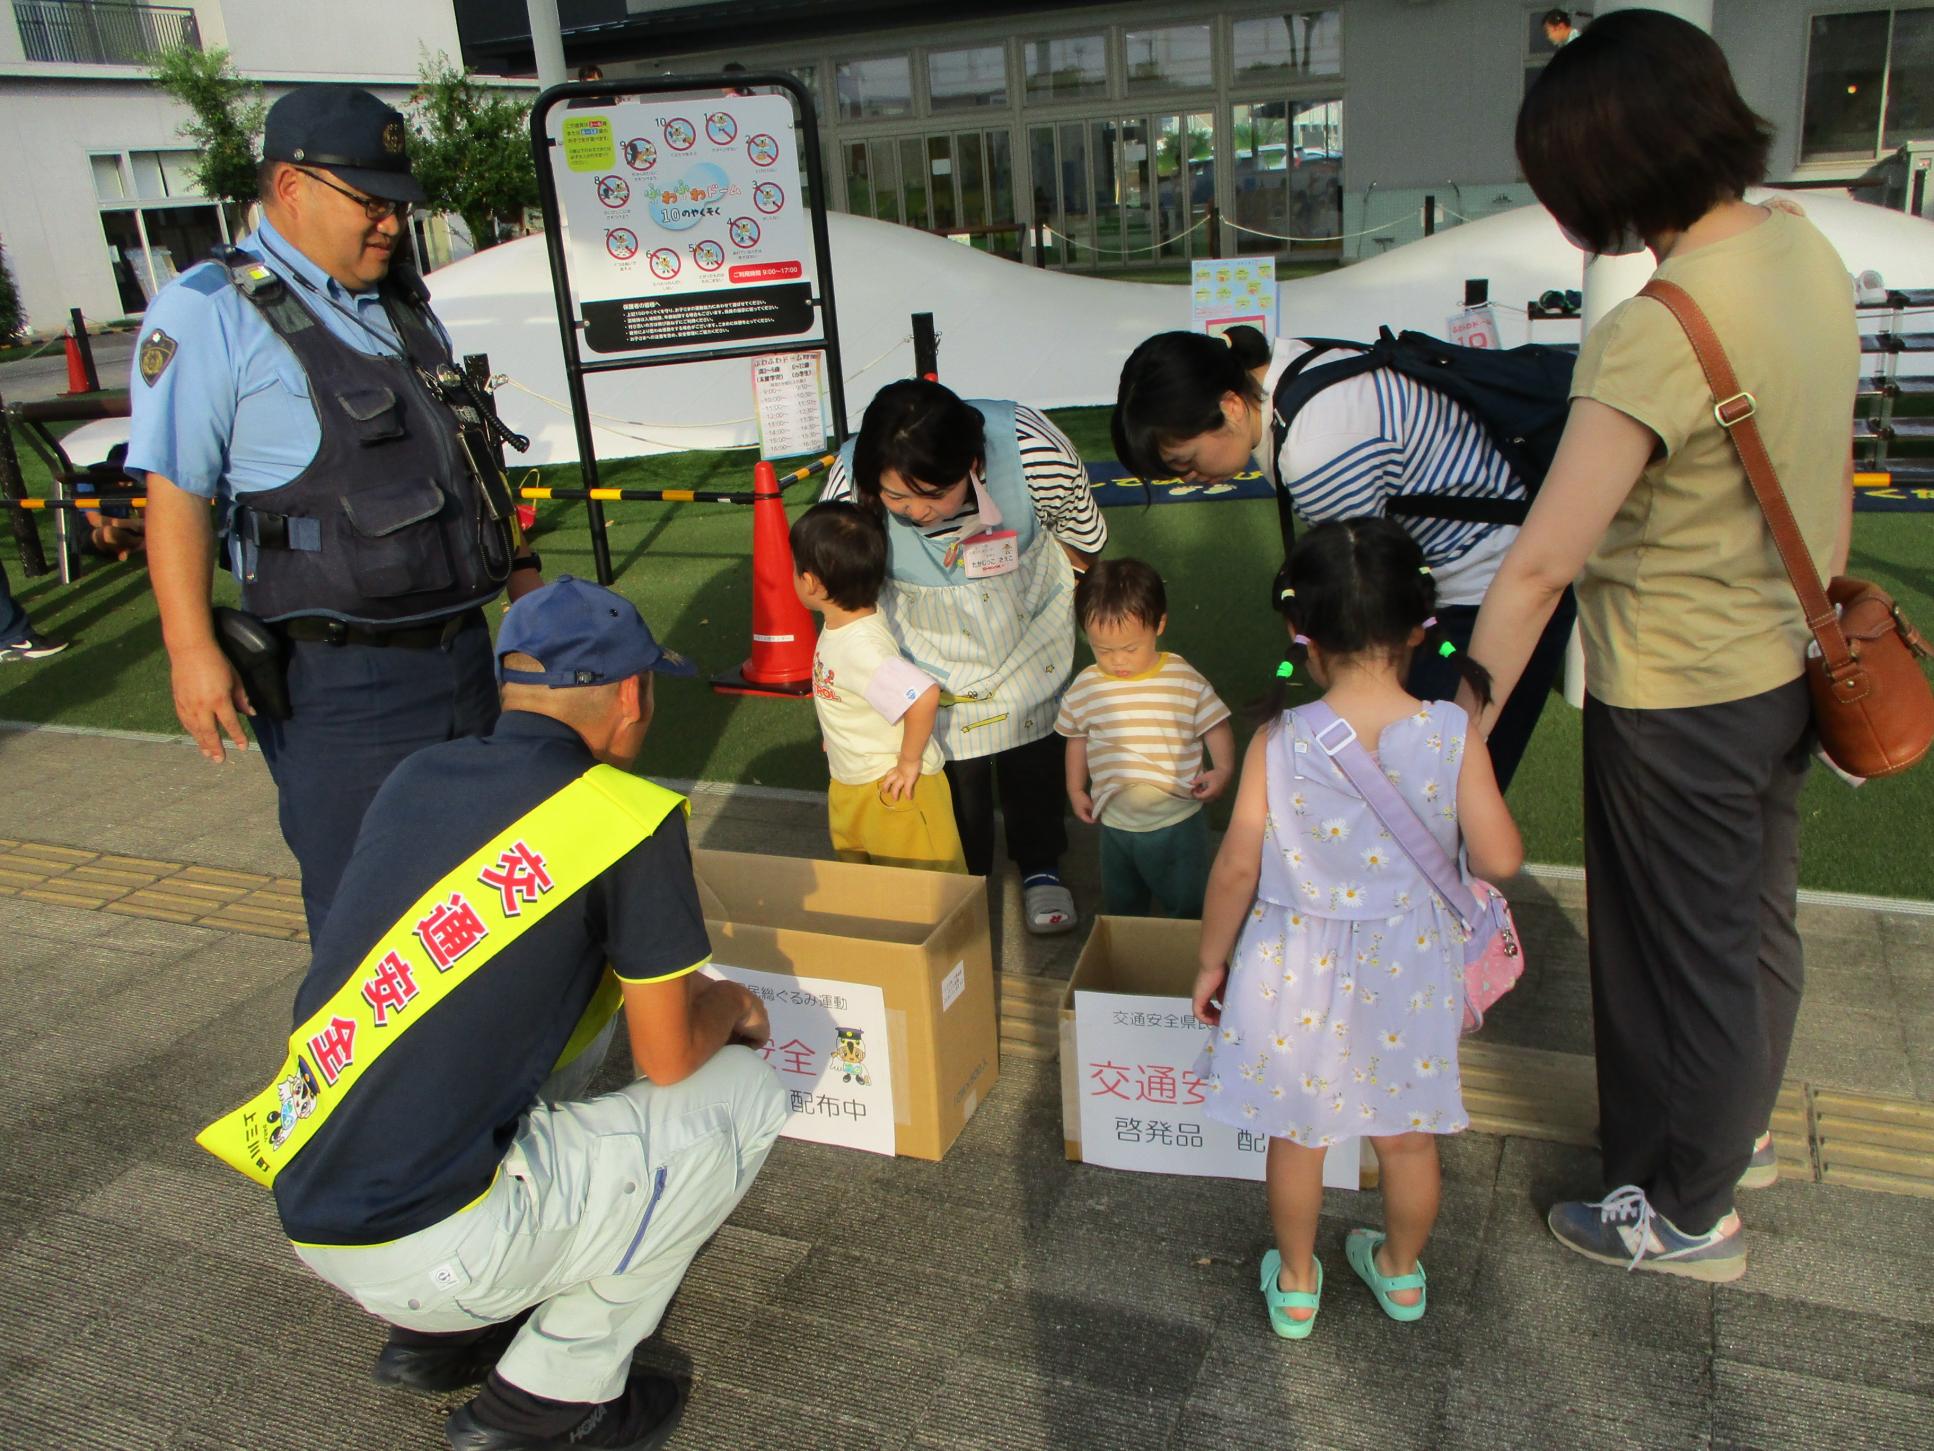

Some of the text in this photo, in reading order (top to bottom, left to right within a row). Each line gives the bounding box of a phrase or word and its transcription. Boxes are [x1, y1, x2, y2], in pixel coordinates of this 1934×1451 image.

[655, 117, 667, 127] 10
[645, 180, 741, 204] ふわふわドーム
[661, 207, 721, 223] 10のやくそく
[309, 841, 553, 1086] 交通安全
[789, 1089, 867, 1122] 配布中
[243, 1112, 270, 1172] 上三川町
[1115, 1117, 1203, 1147] 啓発品
[570, 1404, 607, 1444] HOKA
